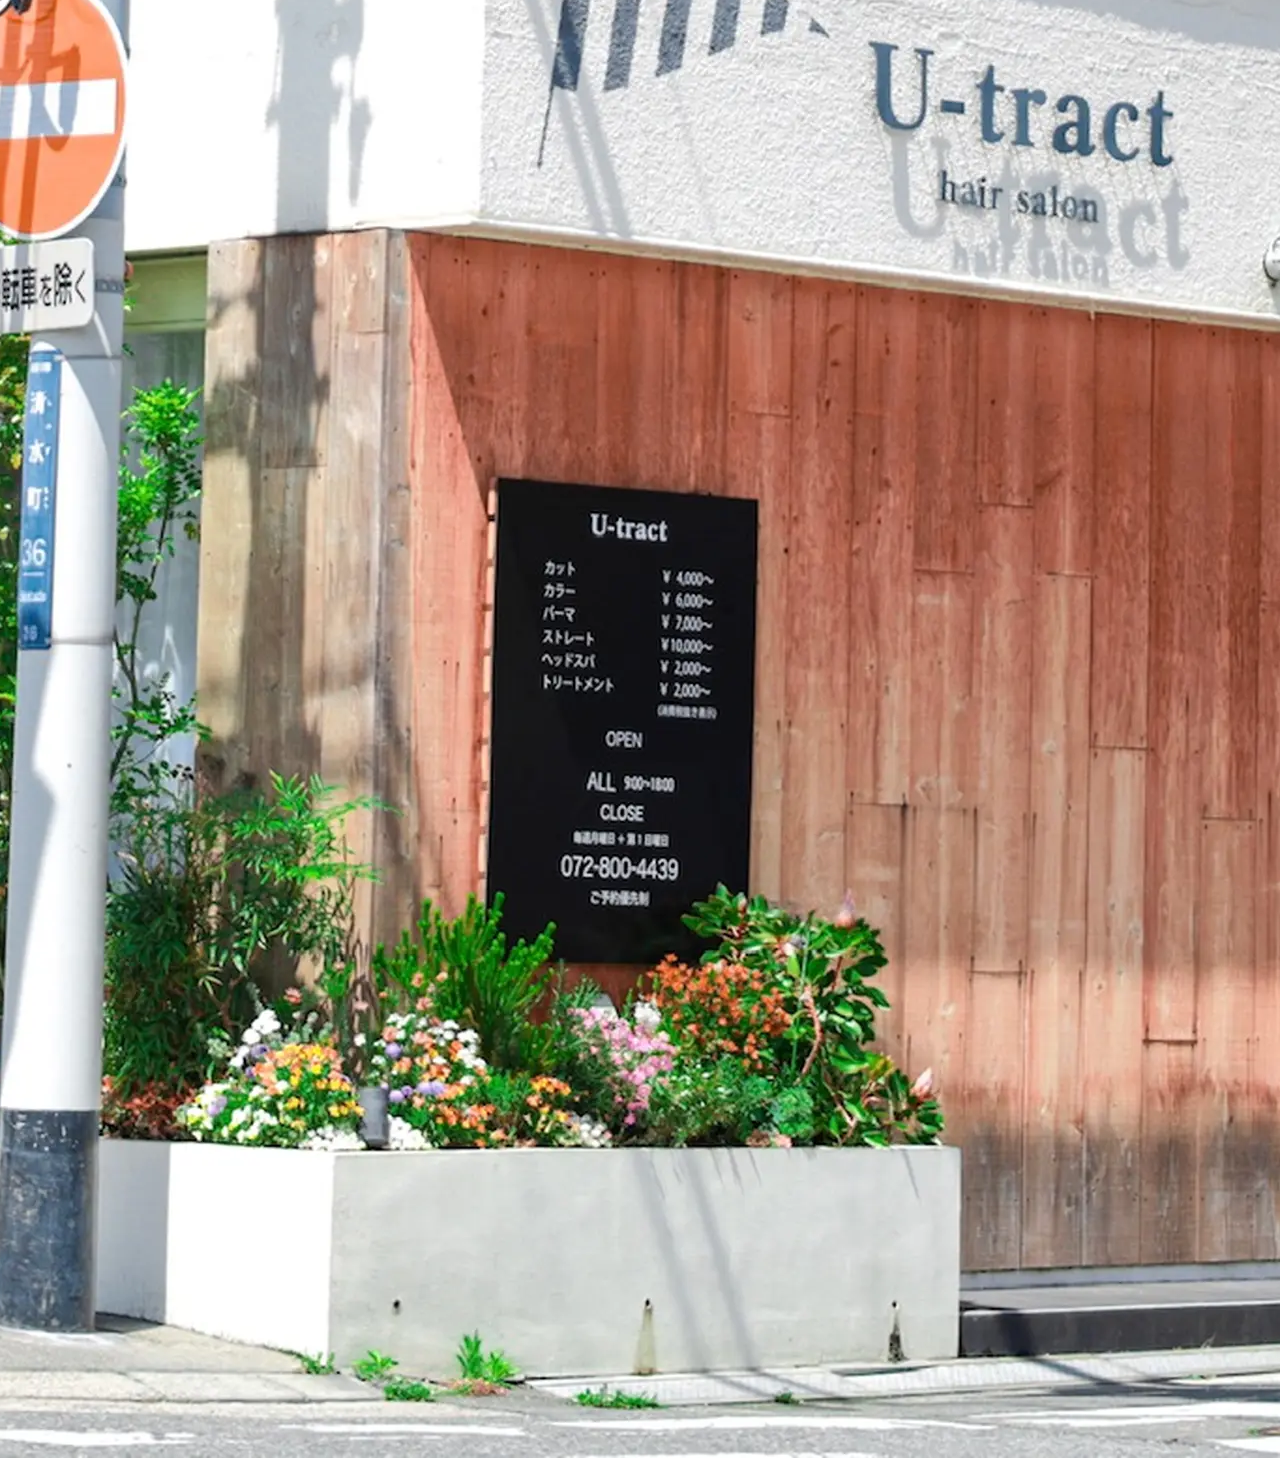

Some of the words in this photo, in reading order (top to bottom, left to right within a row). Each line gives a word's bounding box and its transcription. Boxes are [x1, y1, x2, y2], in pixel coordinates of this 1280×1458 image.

[869, 41, 1174, 167] U-tract
[937, 169, 1004, 210] hair
[1017, 185, 1100, 224] salon
[590, 512, 669, 543] U-tract
[22, 538, 48, 566] 36
[544, 560, 577, 577] カット
[544, 583, 577, 600] カラー
[543, 605, 576, 623] パーマ
[542, 629, 595, 647] ストレート
[541, 652, 596, 669] ヘッドスパ
[542, 673, 616, 694] トリートメント
[605, 730, 643, 749] OPEN
[586, 771, 617, 793] ALL
[600, 804, 644, 823] CLOSE
[561, 854, 679, 881] 072-800-4439
